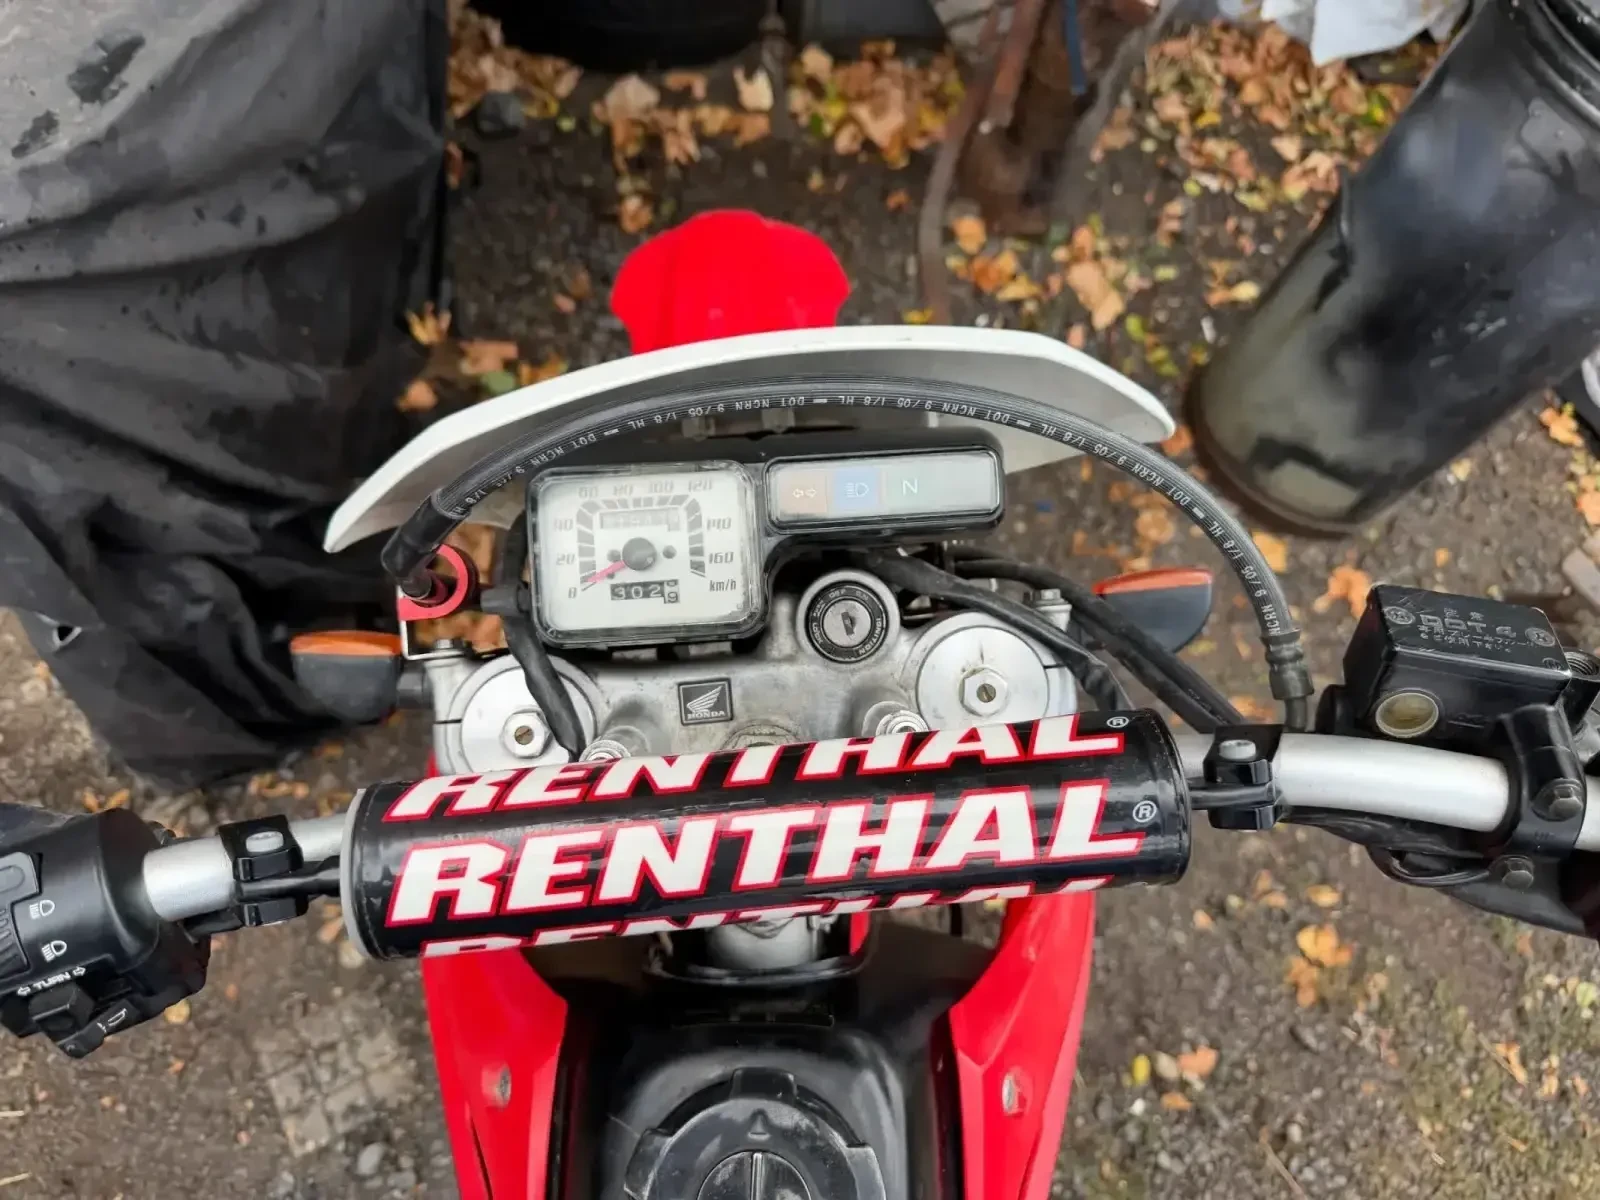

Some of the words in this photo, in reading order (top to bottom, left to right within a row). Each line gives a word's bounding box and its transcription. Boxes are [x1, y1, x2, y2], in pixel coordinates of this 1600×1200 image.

[735, 398, 770, 411] NCRN
[780, 396, 805, 406] DOT
[838, 395, 855, 405] HL
[863, 396, 885, 406] 1/8
[653, 411, 678, 424] 1/8
[941, 404, 976, 417] NCRN
[983, 409, 1010, 423] DOT
[627, 418, 645, 431] HL
[1041, 424, 1057, 436] HL
[572, 431, 597, 450] DOT
[1062, 432, 1085, 447] 1/8
[530, 446, 564, 467] NCRN
[1131, 463, 1165, 487] NCRN
[902, 479, 918, 496] N
[1167, 487, 1192, 505] DOT
[706, 517, 732, 530] 140
[1208, 521, 1225, 537] HL
[556, 553, 575, 565] 20
[708, 551, 734, 565] 160
[709, 578, 737, 592] km/h
[1261, 603, 1281, 636] NCRN
[859, 618, 882, 655] IGNITION
[687, 710, 726, 719] HONDA
[384, 779, 1146, 927] RENTHAL
[33, 972, 71, 990] TURN
